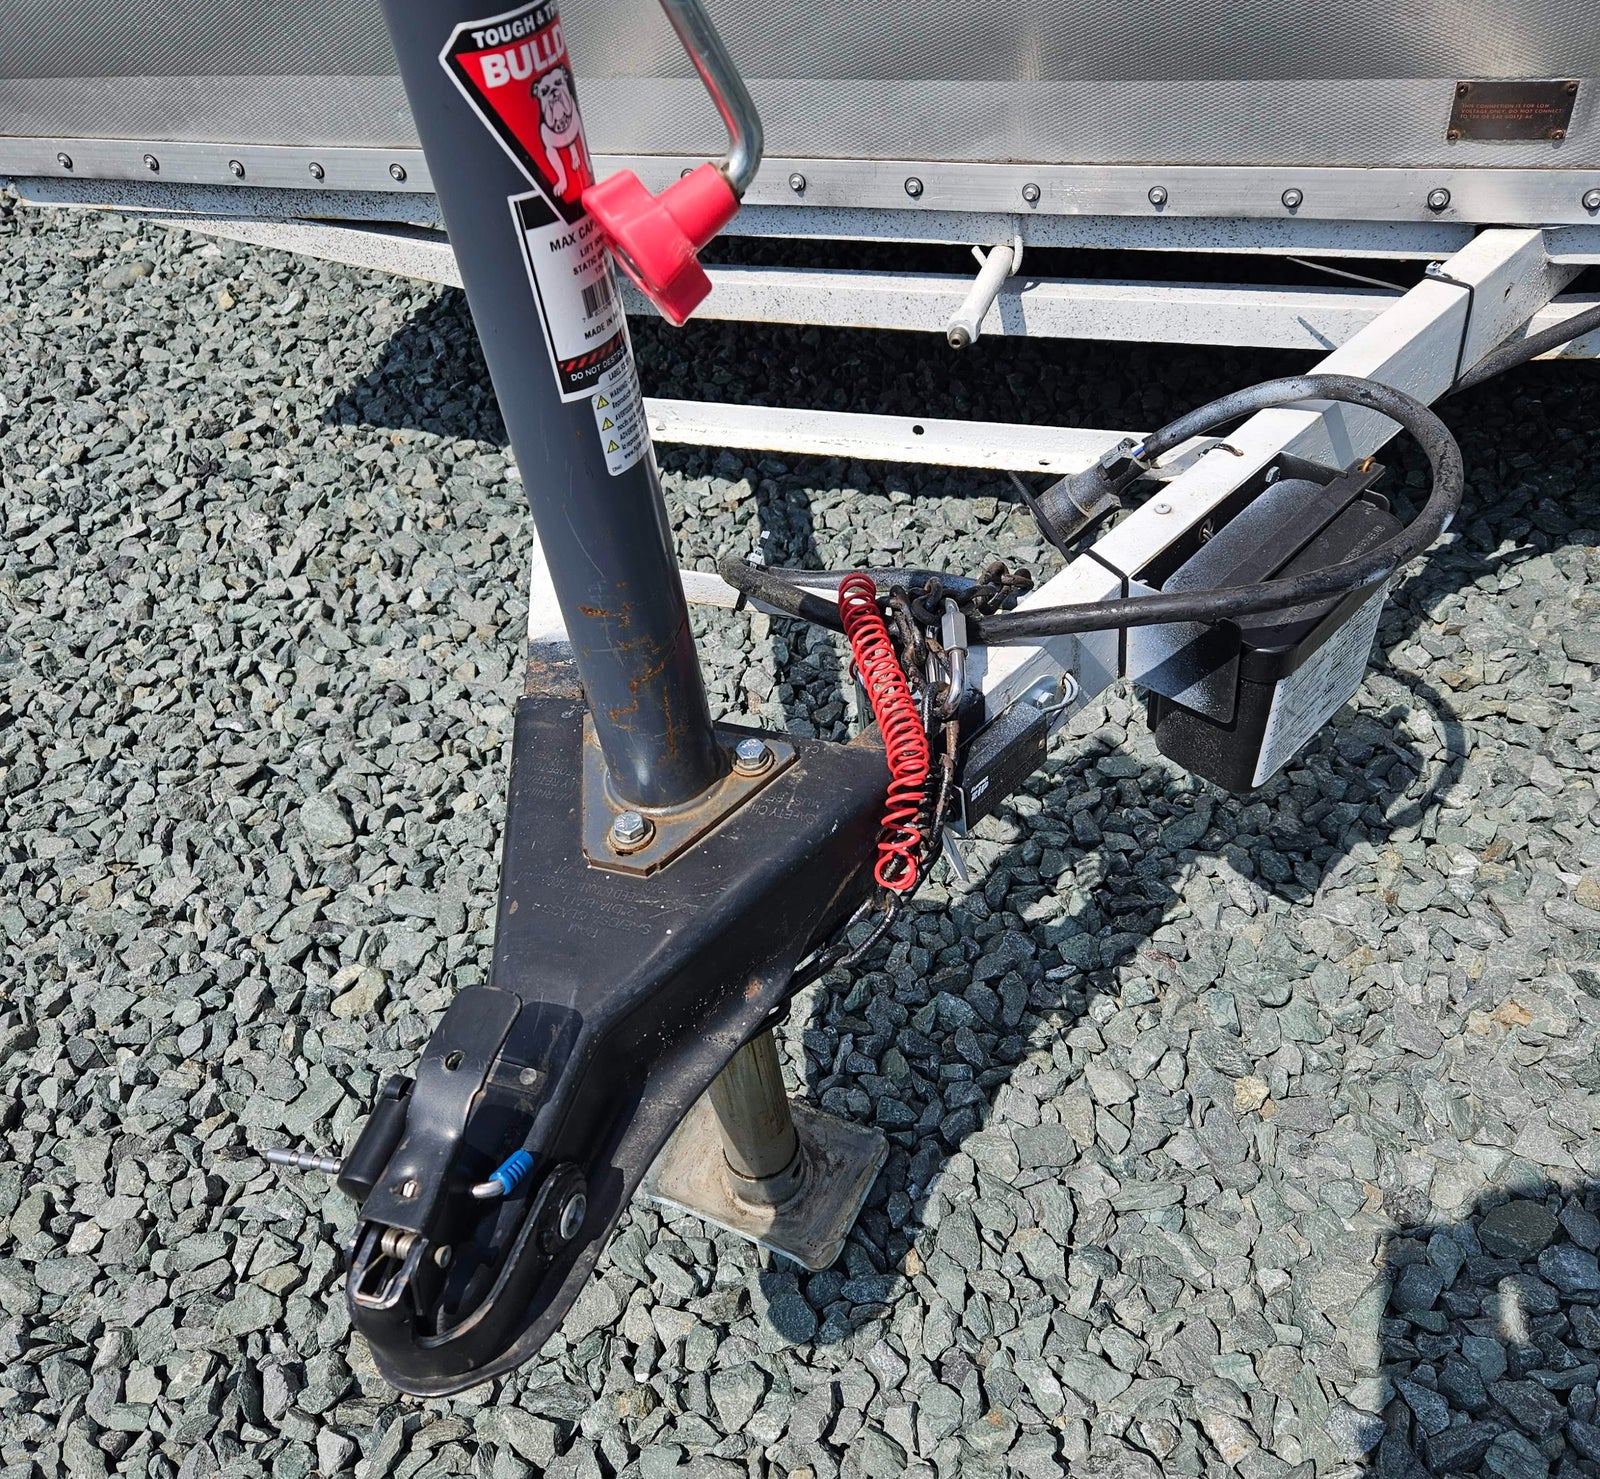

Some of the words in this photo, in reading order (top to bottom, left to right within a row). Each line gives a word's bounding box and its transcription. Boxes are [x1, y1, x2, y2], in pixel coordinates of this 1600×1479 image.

[471, 14, 536, 49] TOUGH
[536, 10, 545, 26] &
[479, 24, 566, 89] BULLD
[549, 232, 577, 252] MAX
[580, 241, 595, 257] LIFT
[573, 255, 597, 275] STATIC
[584, 321, 606, 340] MADE
[570, 371, 584, 382] DO
[585, 363, 602, 378] NOT
